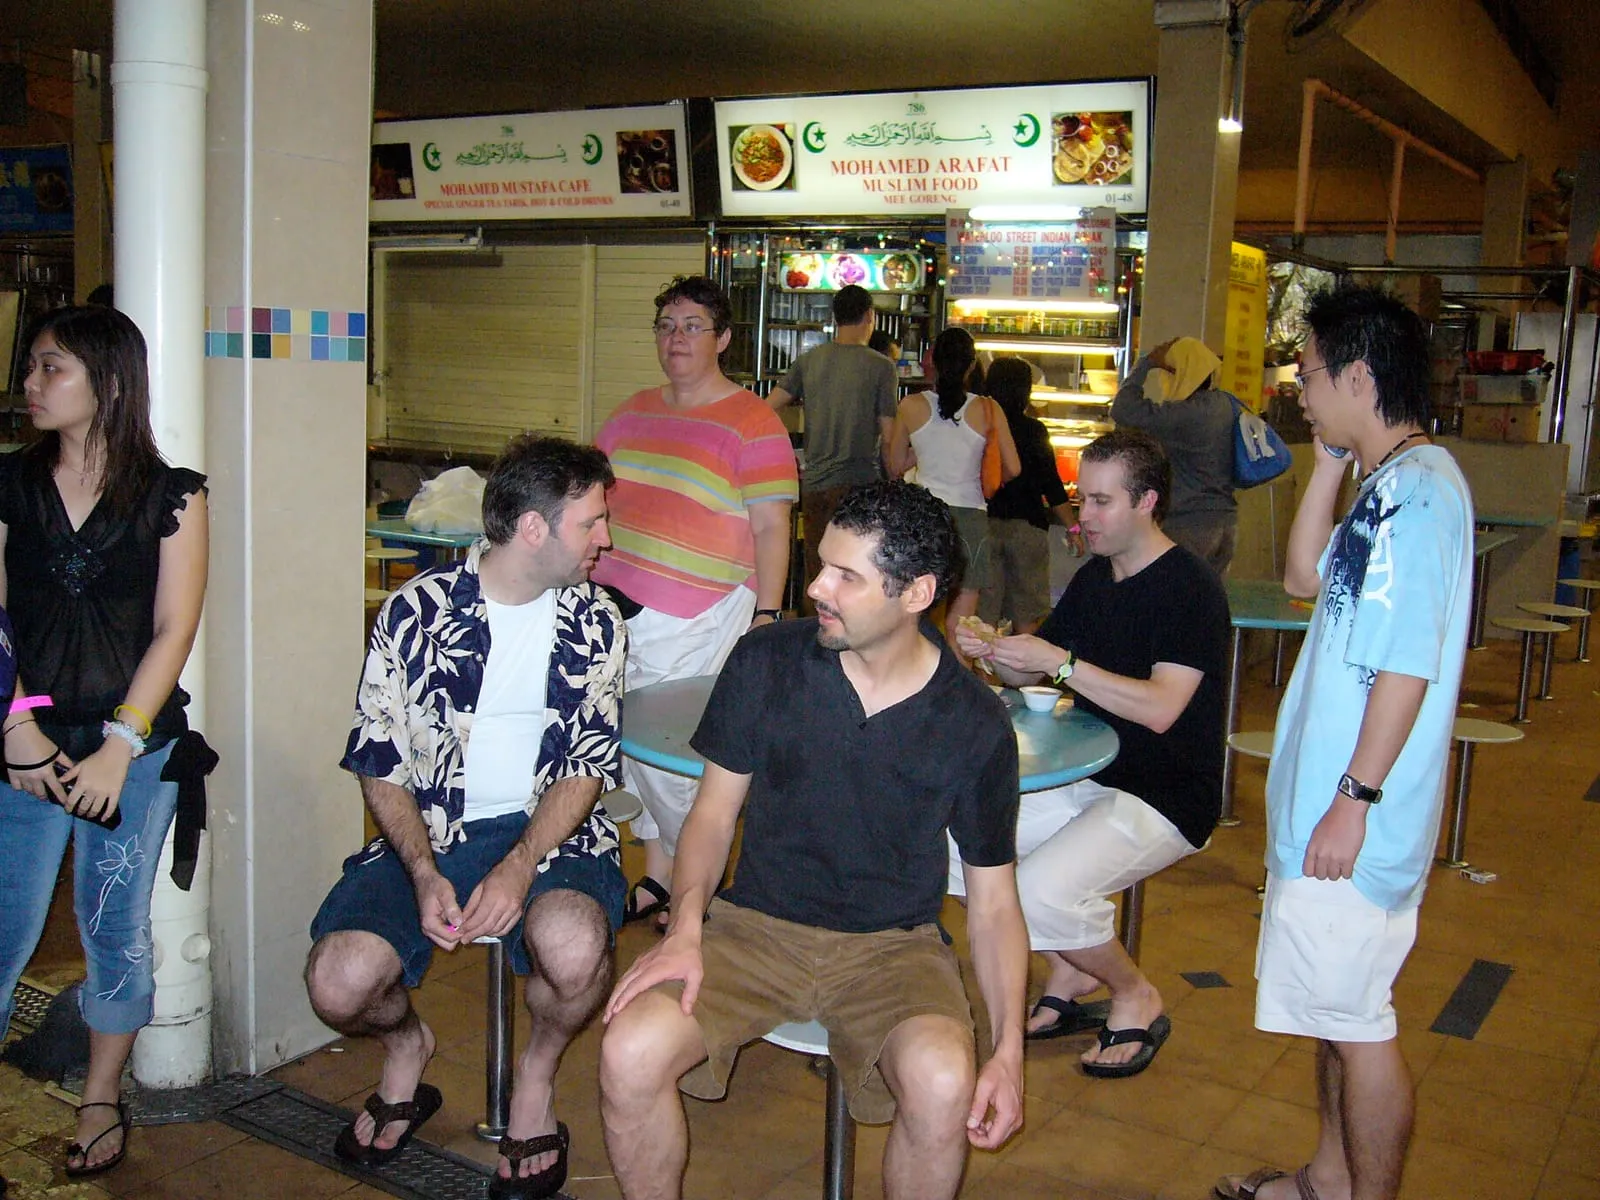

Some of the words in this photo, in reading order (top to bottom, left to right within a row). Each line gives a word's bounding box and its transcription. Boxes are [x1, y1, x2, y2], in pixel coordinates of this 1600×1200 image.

[907, 103, 925, 113] 786
[830, 158, 930, 175] MOHAMED
[935, 156, 1012, 173] ARAFAT
[440, 182, 499, 197] MOHAMED
[502, 181, 557, 194] MUSTAFA
[559, 179, 592, 193] CAFE
[863, 178, 928, 193] MUSLIM
[931, 177, 979, 191] FOOD
[883, 195, 905, 205] MEE
[908, 194, 957, 205] GORENG
[1104, 192, 1133, 204] 01-48
[1006, 231, 1037, 243] STREET
[1040, 231, 1071, 243] INDIAN
